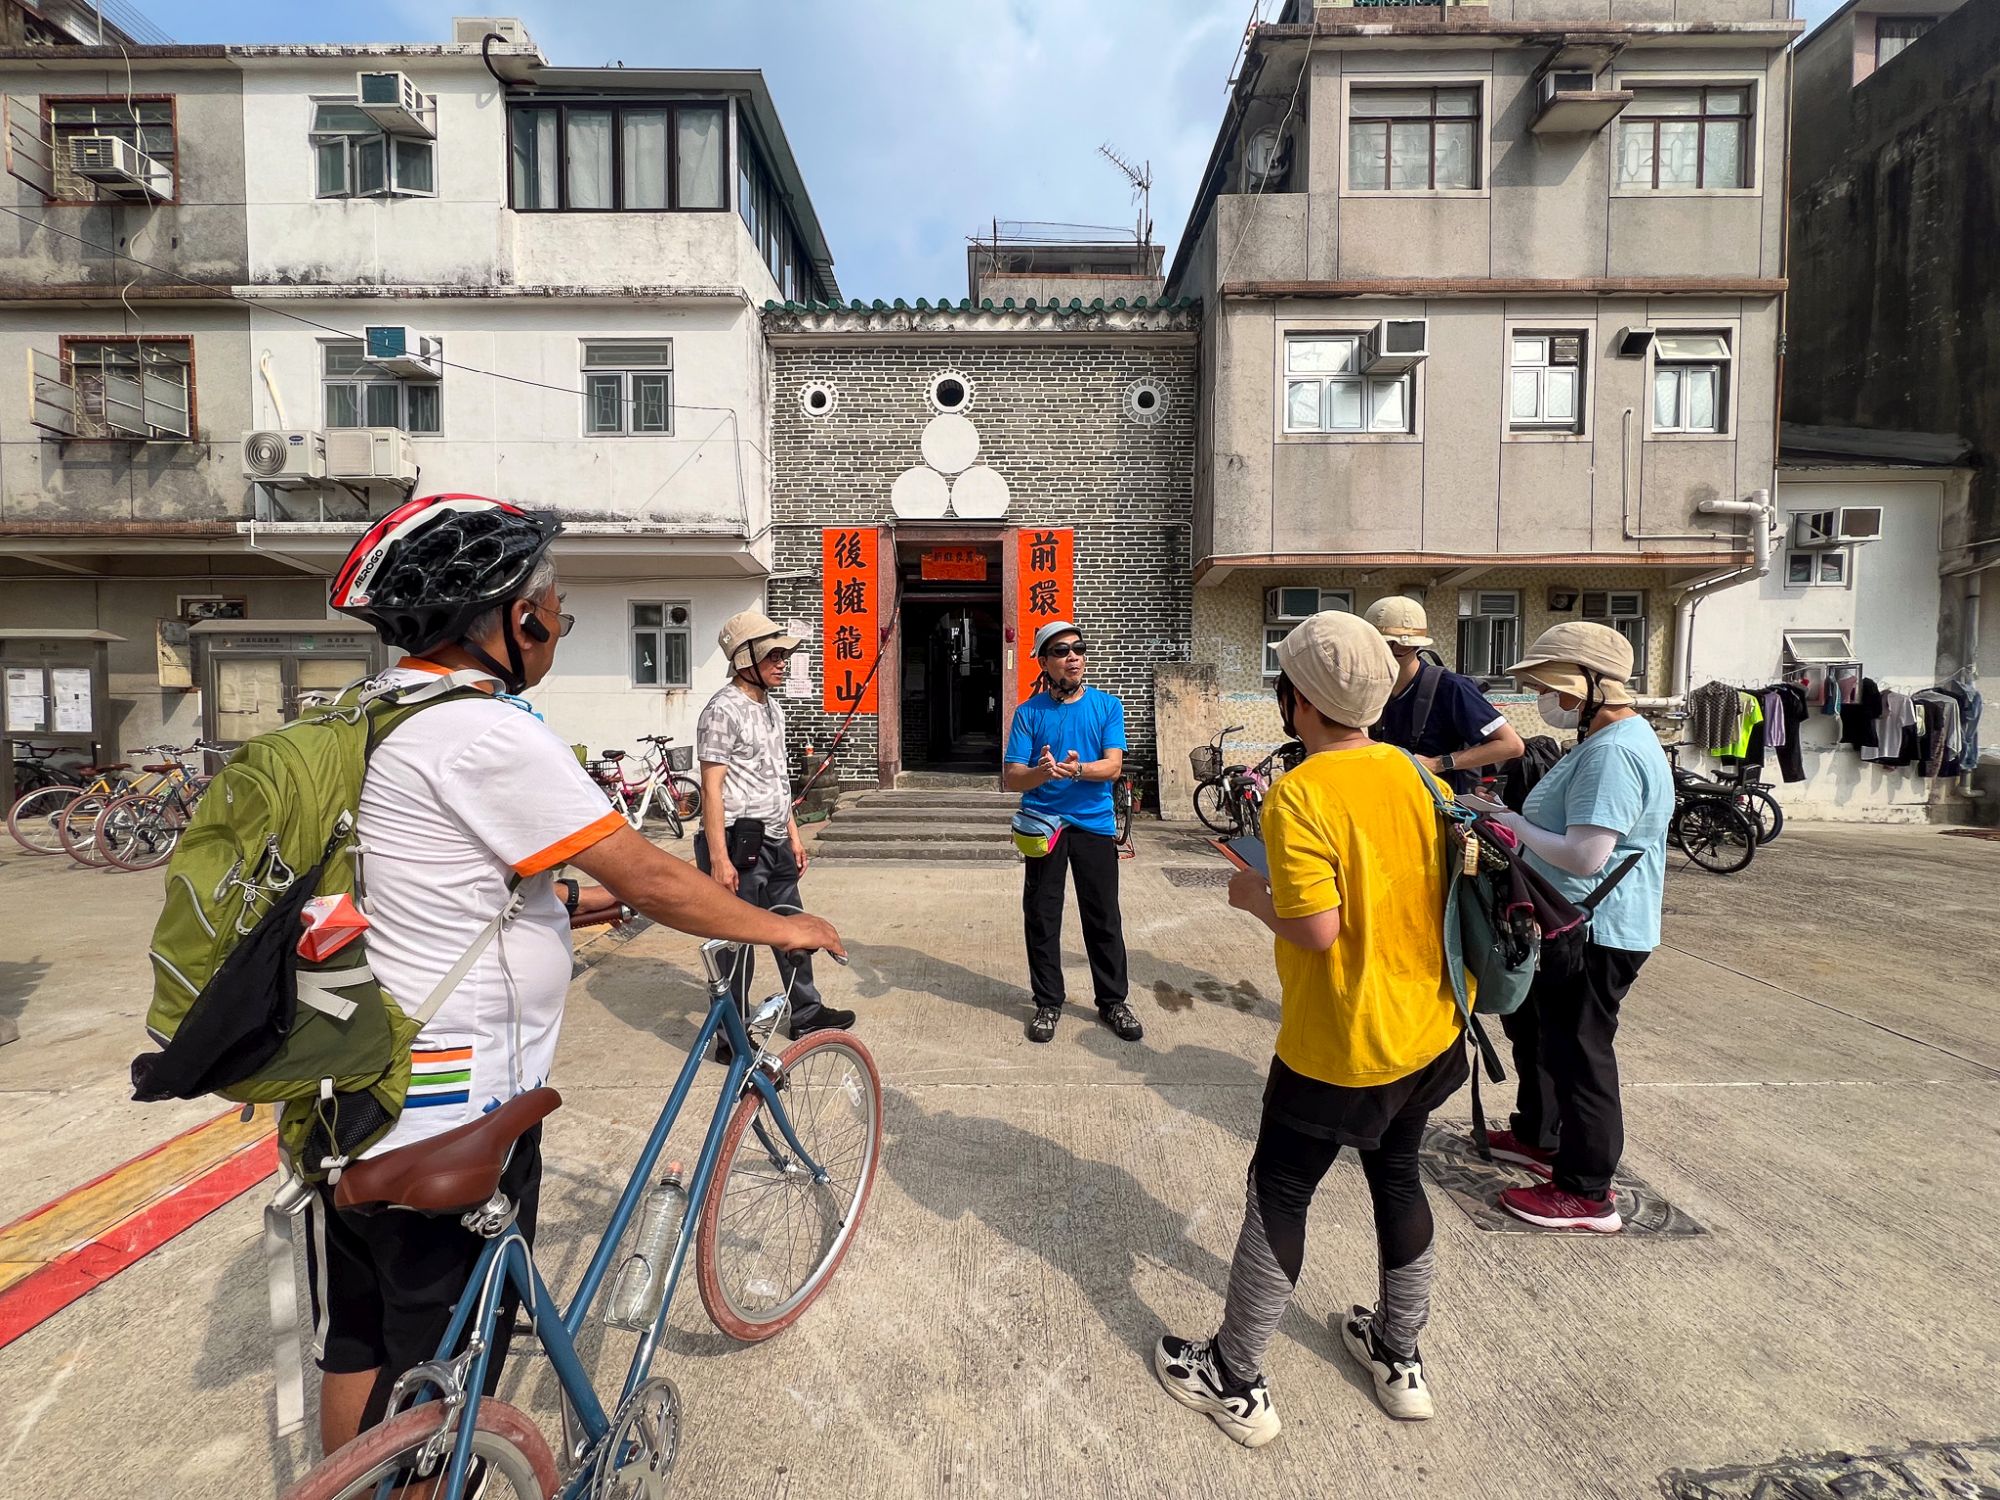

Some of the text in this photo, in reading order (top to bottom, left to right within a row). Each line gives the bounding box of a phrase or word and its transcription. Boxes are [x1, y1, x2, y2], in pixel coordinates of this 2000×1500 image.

[354, 549, 384, 589] AEROGO
[832, 531, 868, 701] 後擁龍山
